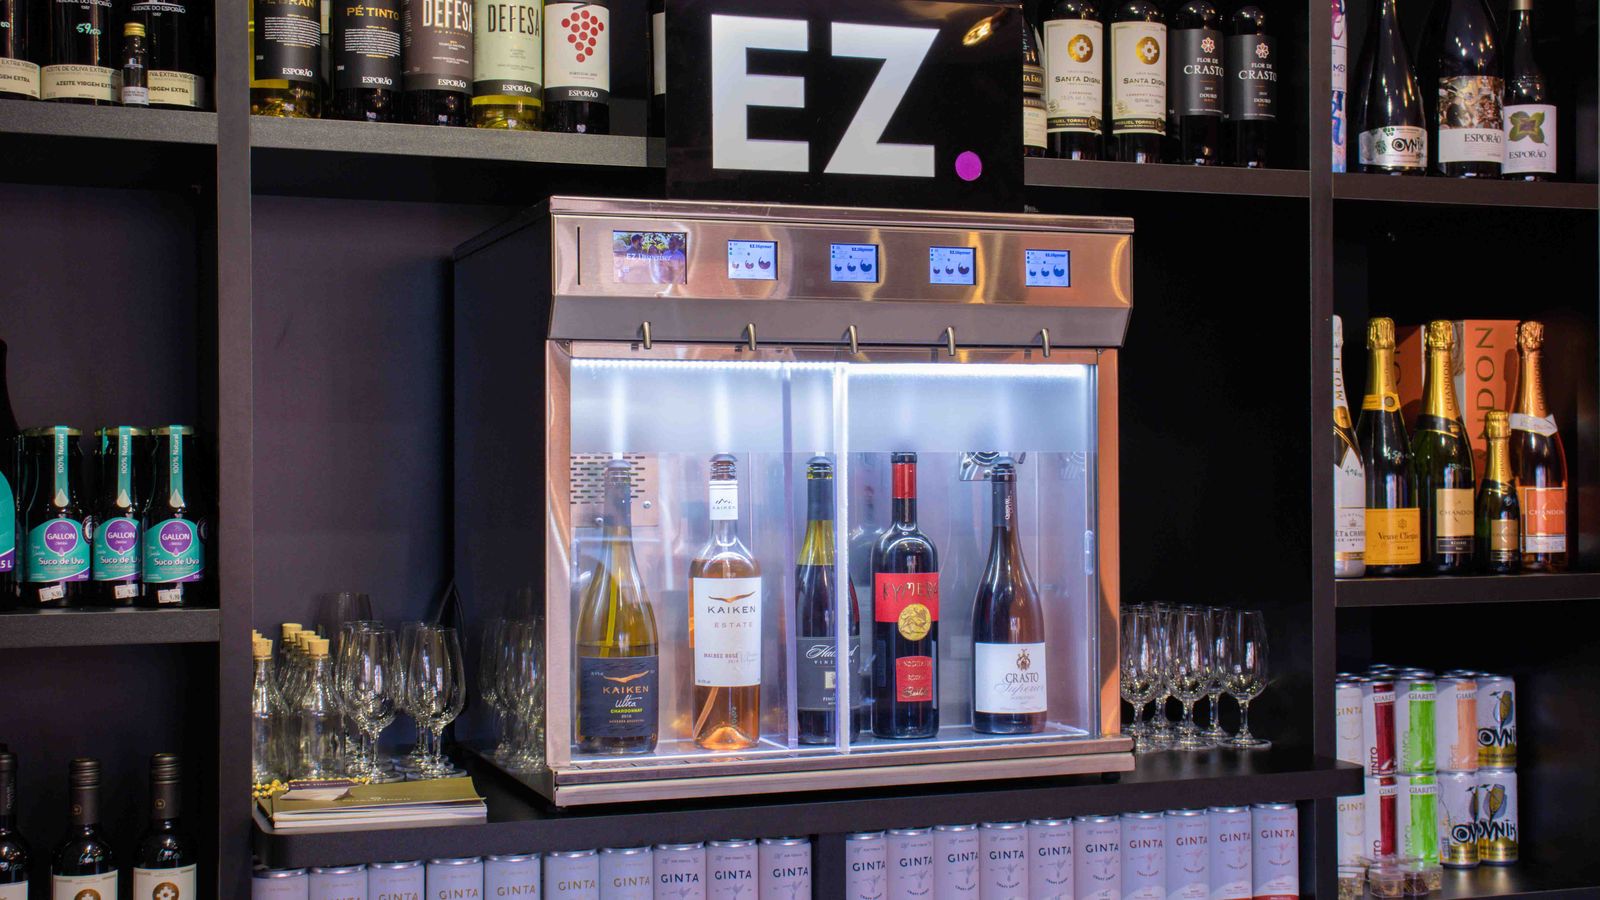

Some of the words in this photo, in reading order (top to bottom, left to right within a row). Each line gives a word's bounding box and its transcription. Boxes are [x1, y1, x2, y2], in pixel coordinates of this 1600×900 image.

[346, 5, 364, 17] PÉ
[367, 8, 400, 20] TINTO
[422, 0, 473, 33] DEFESA
[487, 4, 540, 37] DEFESA
[282, 66, 314, 78] ESPORÃO
[1183, 64, 1225, 78] CRASTO
[1238, 70, 1277, 82] CRASTO
[362, 75, 393, 86] ESPORÃO
[438, 78, 467, 89] ESPORÃO
[502, 83, 532, 94] ESPORÃO
[568, 88, 598, 98] ESPORÃO
[1464, 132, 1501, 144] ESPORÃO
[1508, 150, 1547, 160] ESPORÃO
[47, 532, 76, 541] GALLON
[107, 531, 136, 540] GALLON
[161, 533, 190, 541] GALLON
[39, 557, 57, 566] Suco
[59, 557, 68, 565] de
[100, 557, 117, 565] Suco
[119, 557, 129, 565] de
[154, 558, 172, 566] Suco
[708, 605, 756, 614] KAIKEN
[1005, 672, 1039, 683] CRASTO
[603, 685, 649, 695] KAIKEN
[1370, 747, 1378, 776] TINTO
[1261, 829, 1296, 838] GINTA
[1129, 839, 1163, 849] GINTA
[1176, 836, 1208, 846] GINTA
[1038, 846, 1072, 857] GINTA
[1085, 843, 1119, 853] GINTA
[989, 850, 1025, 860] GINTA
[852, 861, 885, 872] GINTA
[899, 856, 933, 867] GINTA
[714, 870, 752, 880] GINTA
[772, 866, 808, 878] GINTA
[660, 873, 699, 884] GINTA
[558, 879, 596, 891] GINTA
[438, 888, 479, 900] GINTA
[496, 885, 536, 897] GINTA
